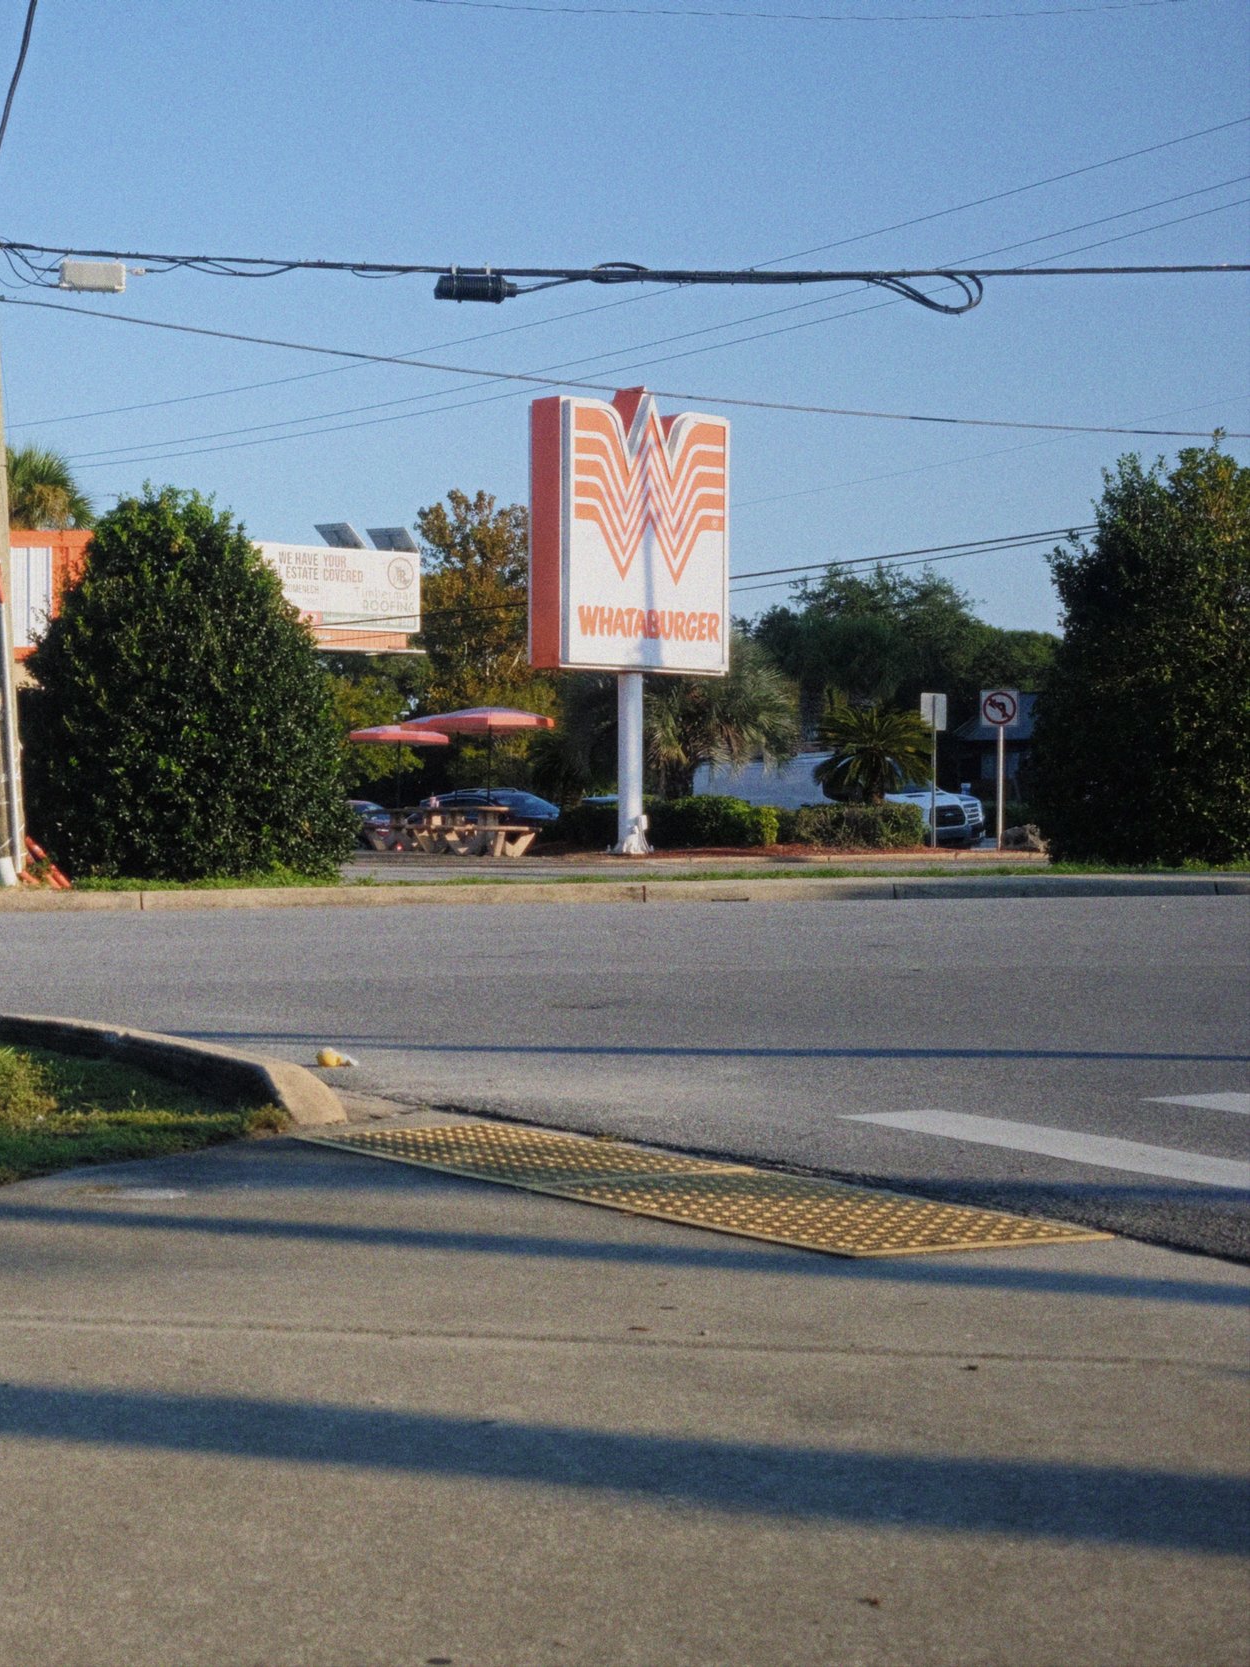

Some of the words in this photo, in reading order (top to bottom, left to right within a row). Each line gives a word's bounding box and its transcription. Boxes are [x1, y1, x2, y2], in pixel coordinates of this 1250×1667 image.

[278, 551, 293, 565] WE
[294, 552, 319, 567] HAVE
[323, 554, 347, 569] YOUR
[285, 566, 319, 580] ESTATE
[323, 568, 364, 583] COVERED
[363, 599, 415, 613] ROOFING
[578, 604, 720, 642] WHATABURGER
